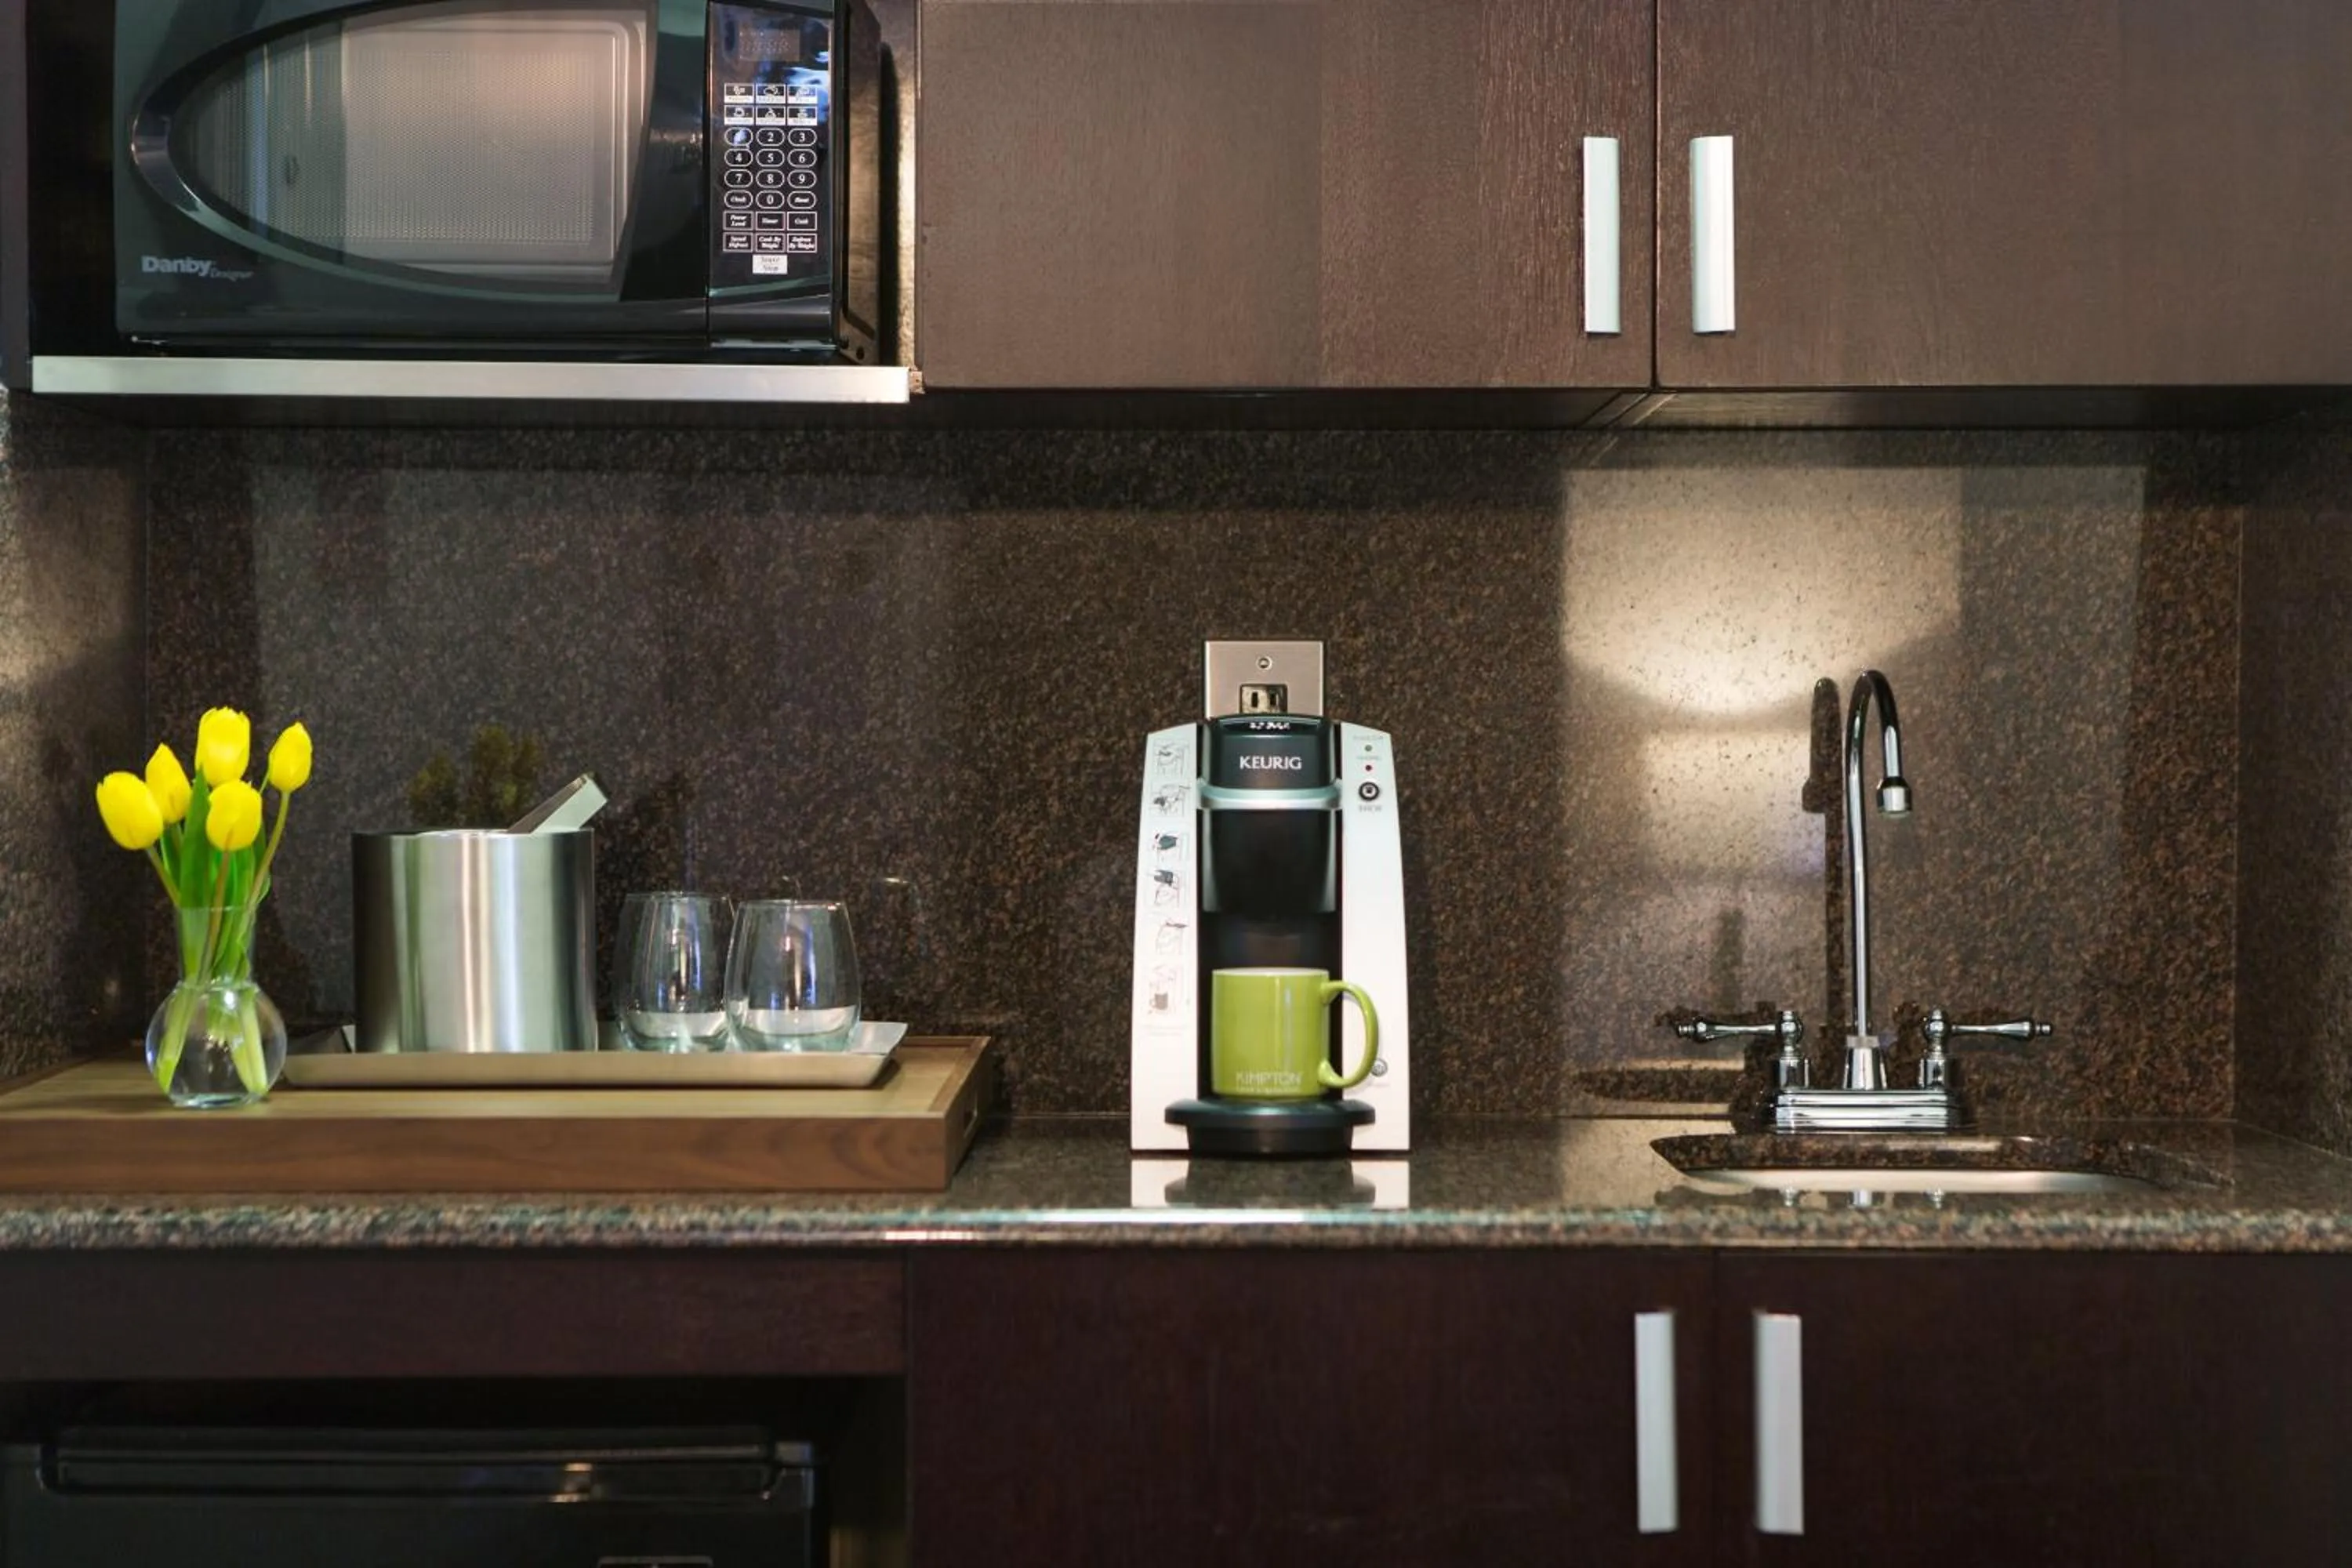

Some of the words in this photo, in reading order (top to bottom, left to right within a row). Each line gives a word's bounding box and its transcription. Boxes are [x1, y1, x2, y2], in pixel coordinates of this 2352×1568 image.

[767, 132, 774, 142] 2
[799, 132, 805, 143] 3
[735, 153, 742, 162] 4
[767, 153, 774, 163] 5
[798, 153, 806, 163] 6
[735, 173, 742, 183] 7
[767, 173, 774, 183] 8
[798, 174, 805, 184] 9
[766, 194, 774, 205] 0
[141, 256, 212, 277] Danby
[1239, 755, 1302, 770] KEURIG
[1236, 1071, 1302, 1086] KIMPTON
